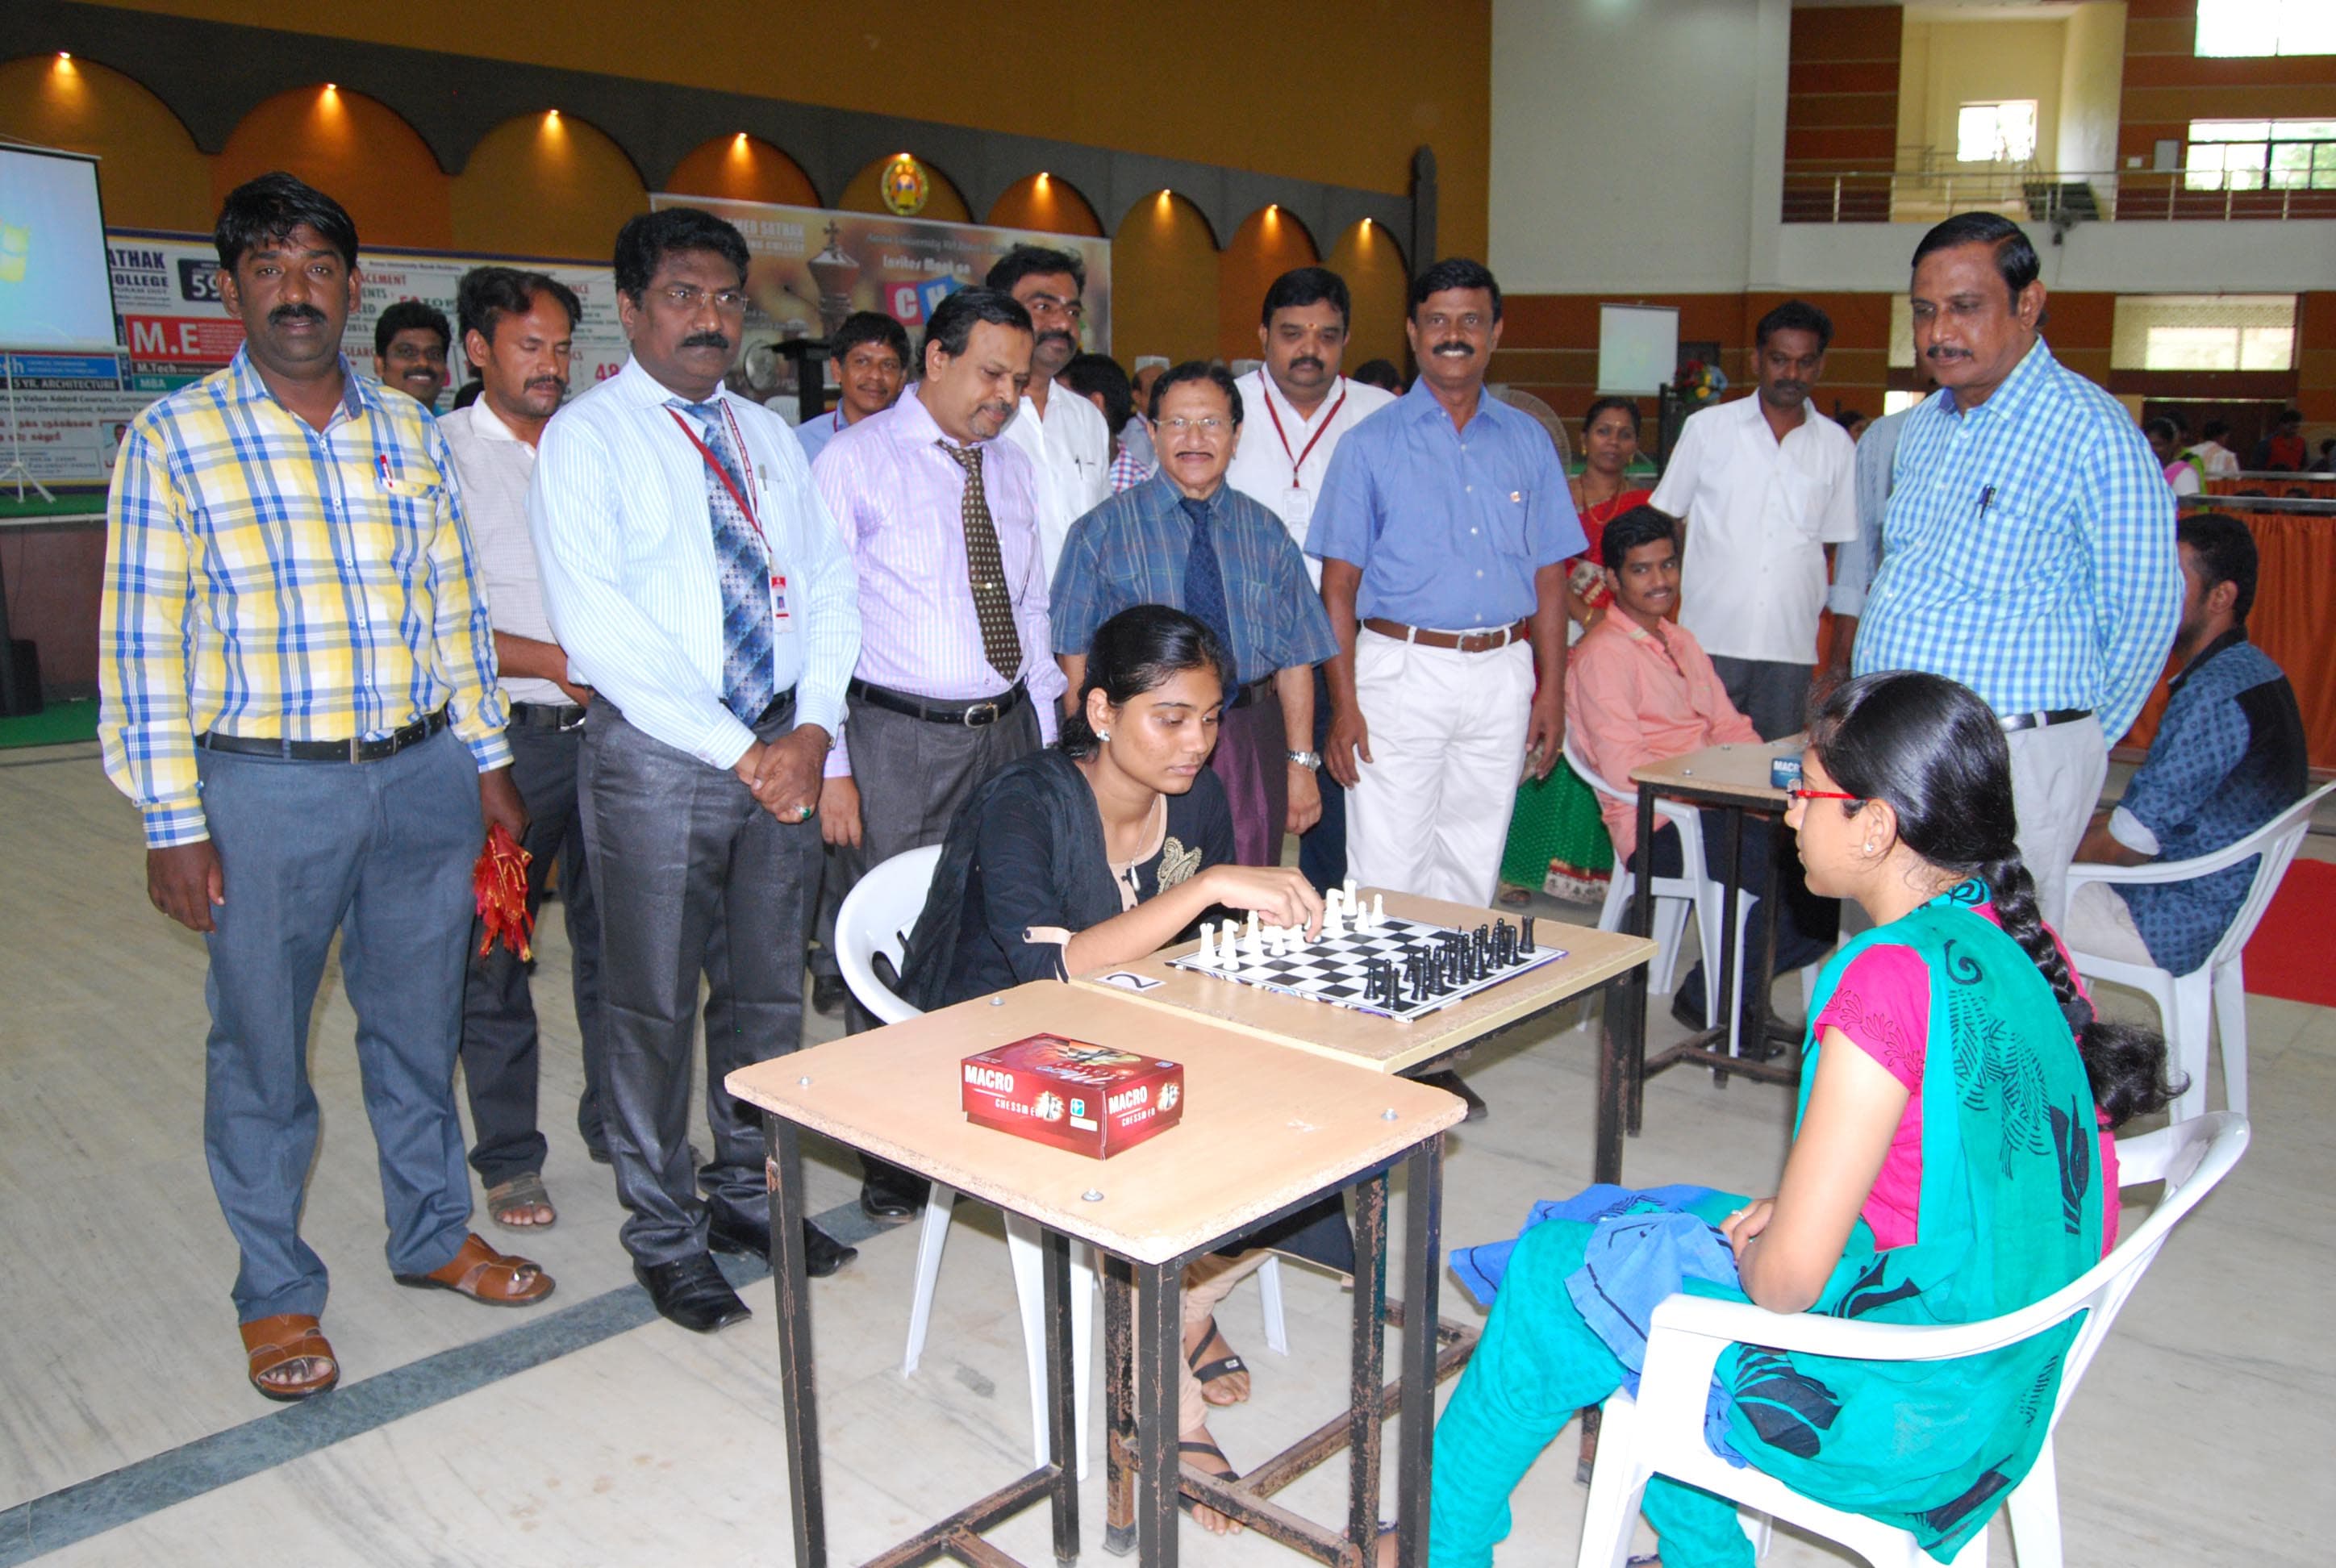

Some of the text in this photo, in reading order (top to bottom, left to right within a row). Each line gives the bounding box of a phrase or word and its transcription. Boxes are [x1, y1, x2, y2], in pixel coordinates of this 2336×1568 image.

[133, 322, 201, 355] M.E
[136, 362, 177, 374] M.Tech
[41, 380, 116, 390] ARCHITECTURE
[1774, 760, 1800, 773] MACR
[965, 1064, 1014, 1094] MACRO
[1108, 1086, 1148, 1115] MACRO
